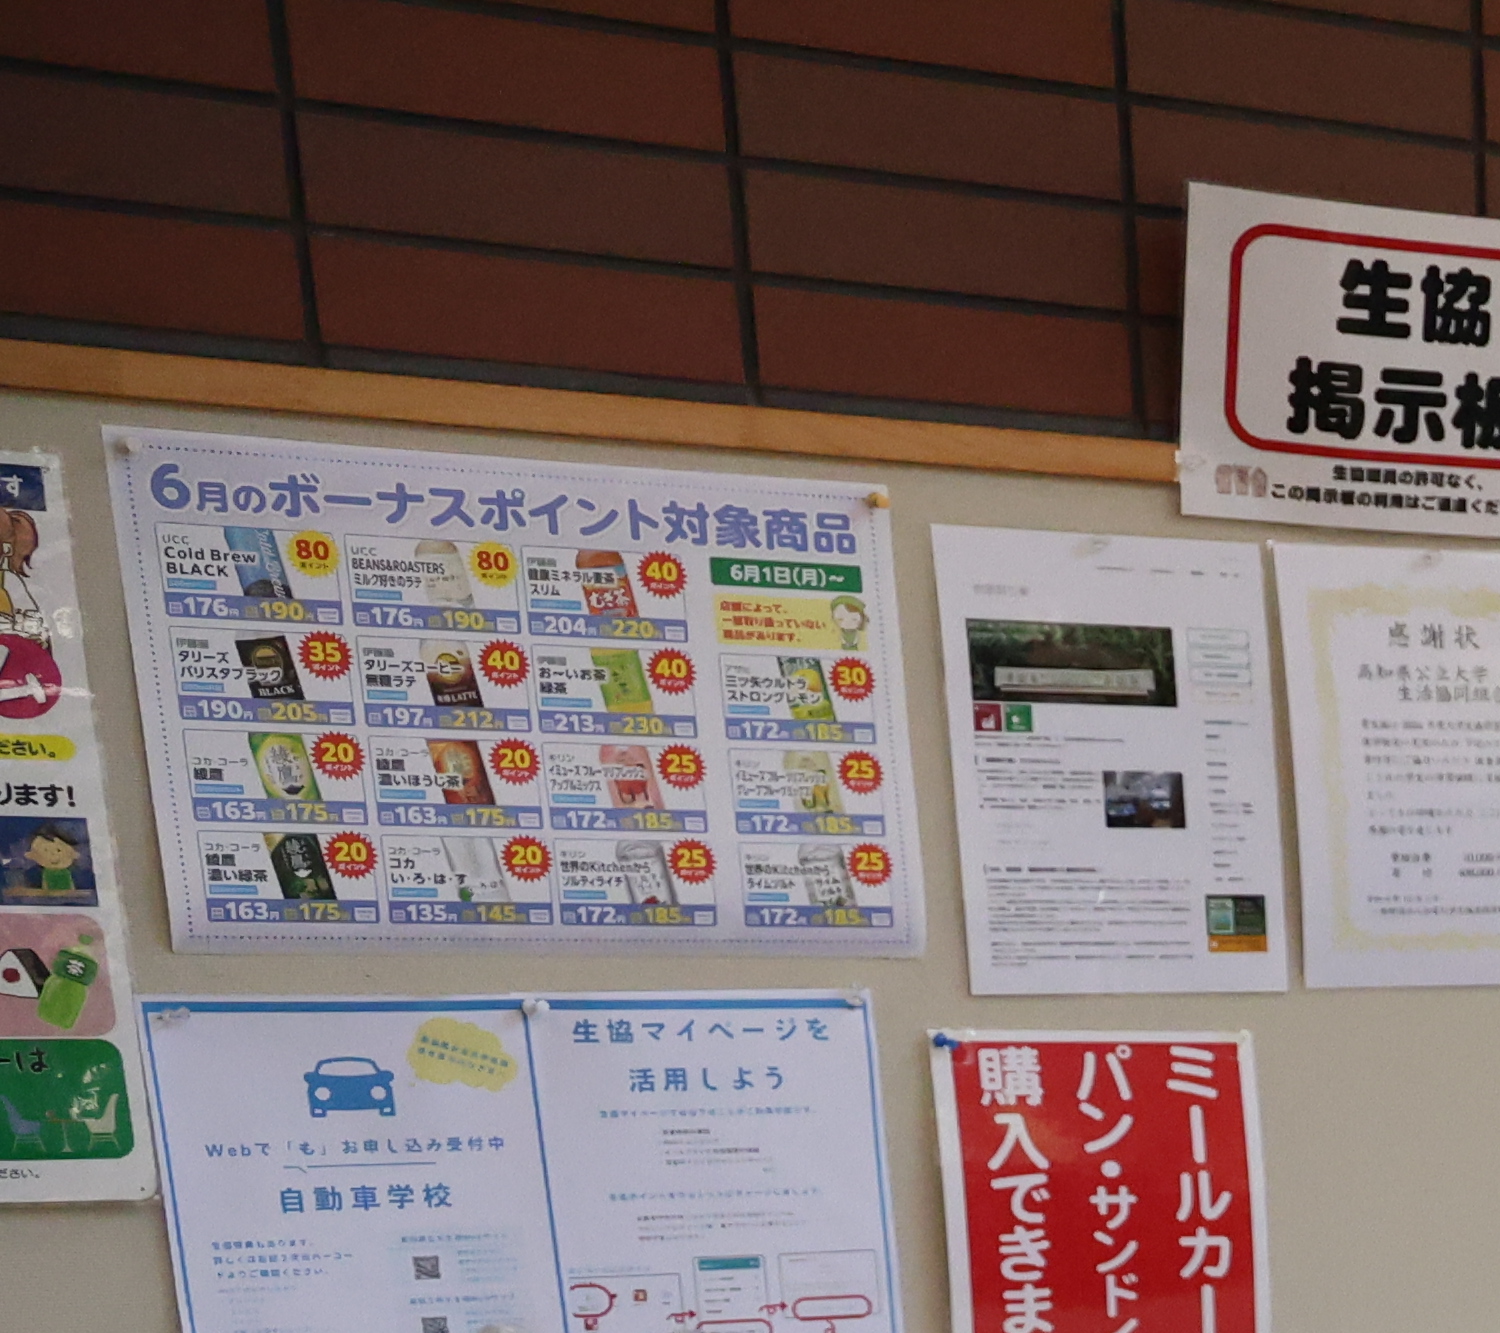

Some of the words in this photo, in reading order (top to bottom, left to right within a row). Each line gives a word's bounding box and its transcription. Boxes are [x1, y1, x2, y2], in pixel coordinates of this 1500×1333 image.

[1336, 259, 1492, 347] 生協
[151, 463, 857, 555] 6月のボーナスポイント対象商品
[164, 546, 204, 561] Cold
[210, 549, 256, 564] Brew
[295, 539, 330, 561] 80
[166, 563, 229, 578] BLACK
[352, 558, 445, 575] BEANS&ROASTERS
[477, 551, 509, 572] 80
[646, 561, 678, 582] 40
[308, 641, 342, 662] 35
[487, 650, 520, 671] 40
[655, 657, 687, 678] 40
[837, 666, 867, 686] 30
[320, 743, 354, 764] 20
[500, 749, 531, 769] 20
[665, 753, 696, 774] 25
[845, 760, 875, 780] 25
[334, 843, 367, 863] 20
[511, 846, 543, 866] 20
[676, 848, 707, 868] 25
[855, 852, 884, 872] 25
[572, 1017, 830, 1045] 生協マイページを
[629, 1066, 786, 1093] 活用しよう
[279, 1183, 453, 1214] 自動車学校
